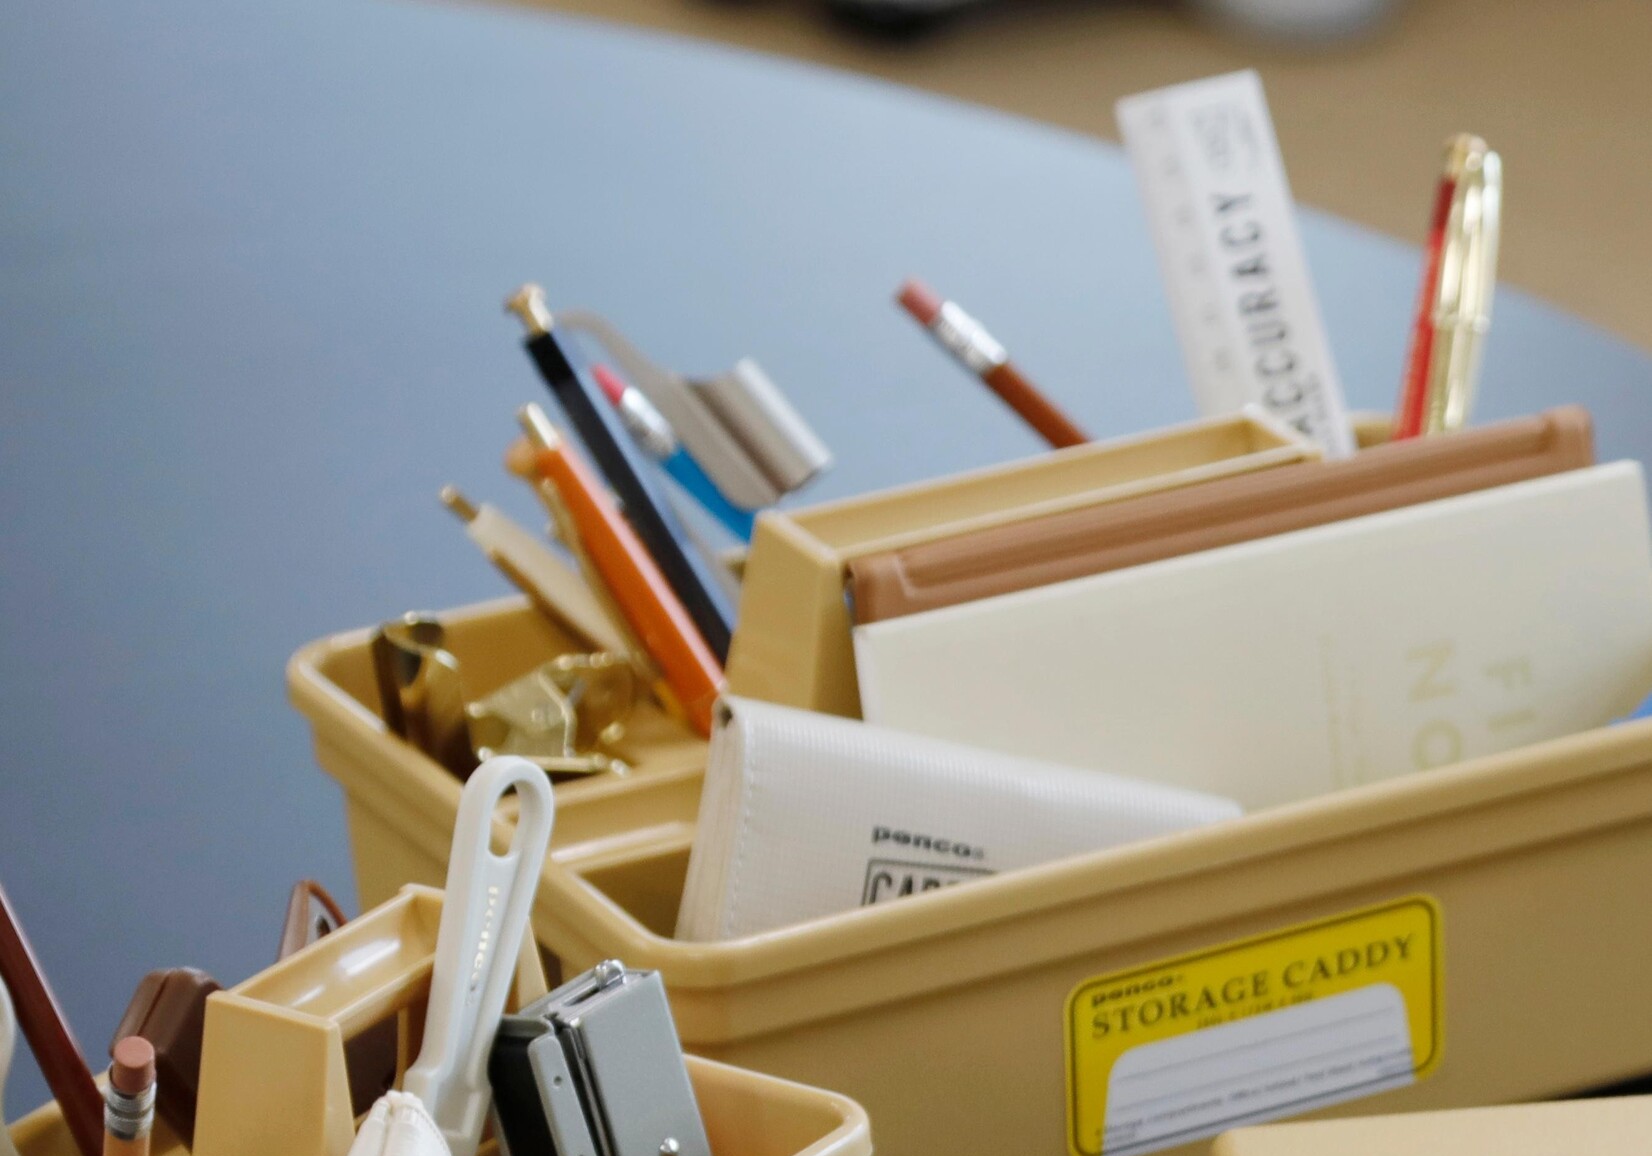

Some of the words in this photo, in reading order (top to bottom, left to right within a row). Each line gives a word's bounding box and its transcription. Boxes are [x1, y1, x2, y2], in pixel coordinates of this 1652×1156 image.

[1209, 192, 1315, 437] ACCURACY
[1091, 969, 1270, 1040] STORAGE
[1281, 932, 1416, 989] CADDY
